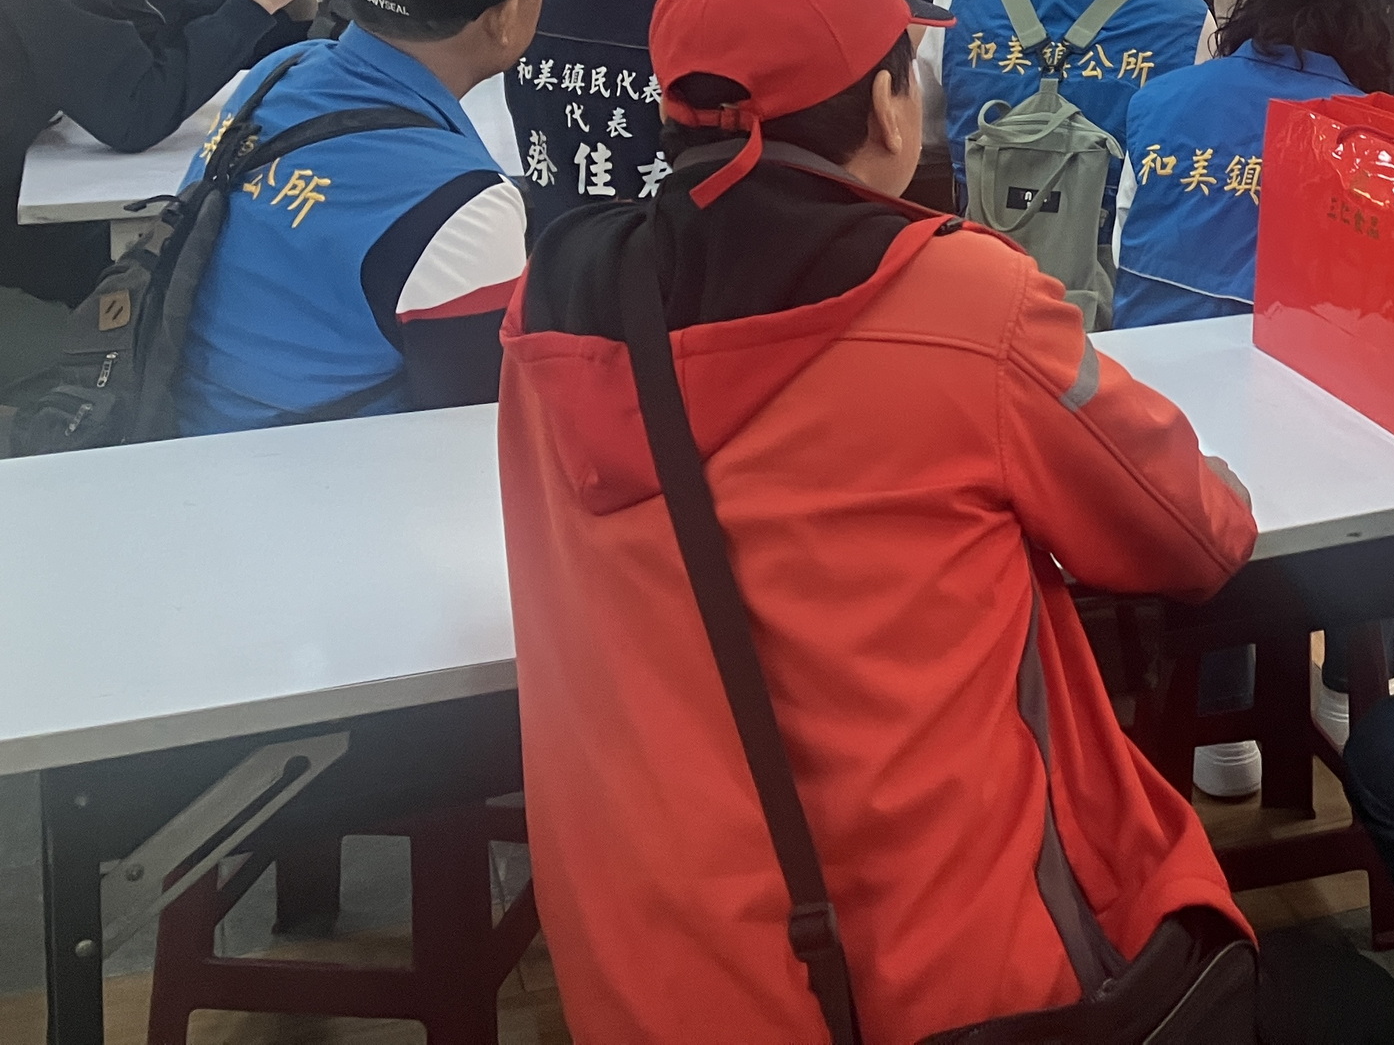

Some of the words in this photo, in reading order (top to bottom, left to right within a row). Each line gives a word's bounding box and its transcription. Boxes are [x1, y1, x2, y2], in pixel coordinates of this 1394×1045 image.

[516, 56, 662, 104] 和美鎮民代表
[565, 102, 634, 139] 代表
[1137, 144, 1264, 206] 和美鎮
